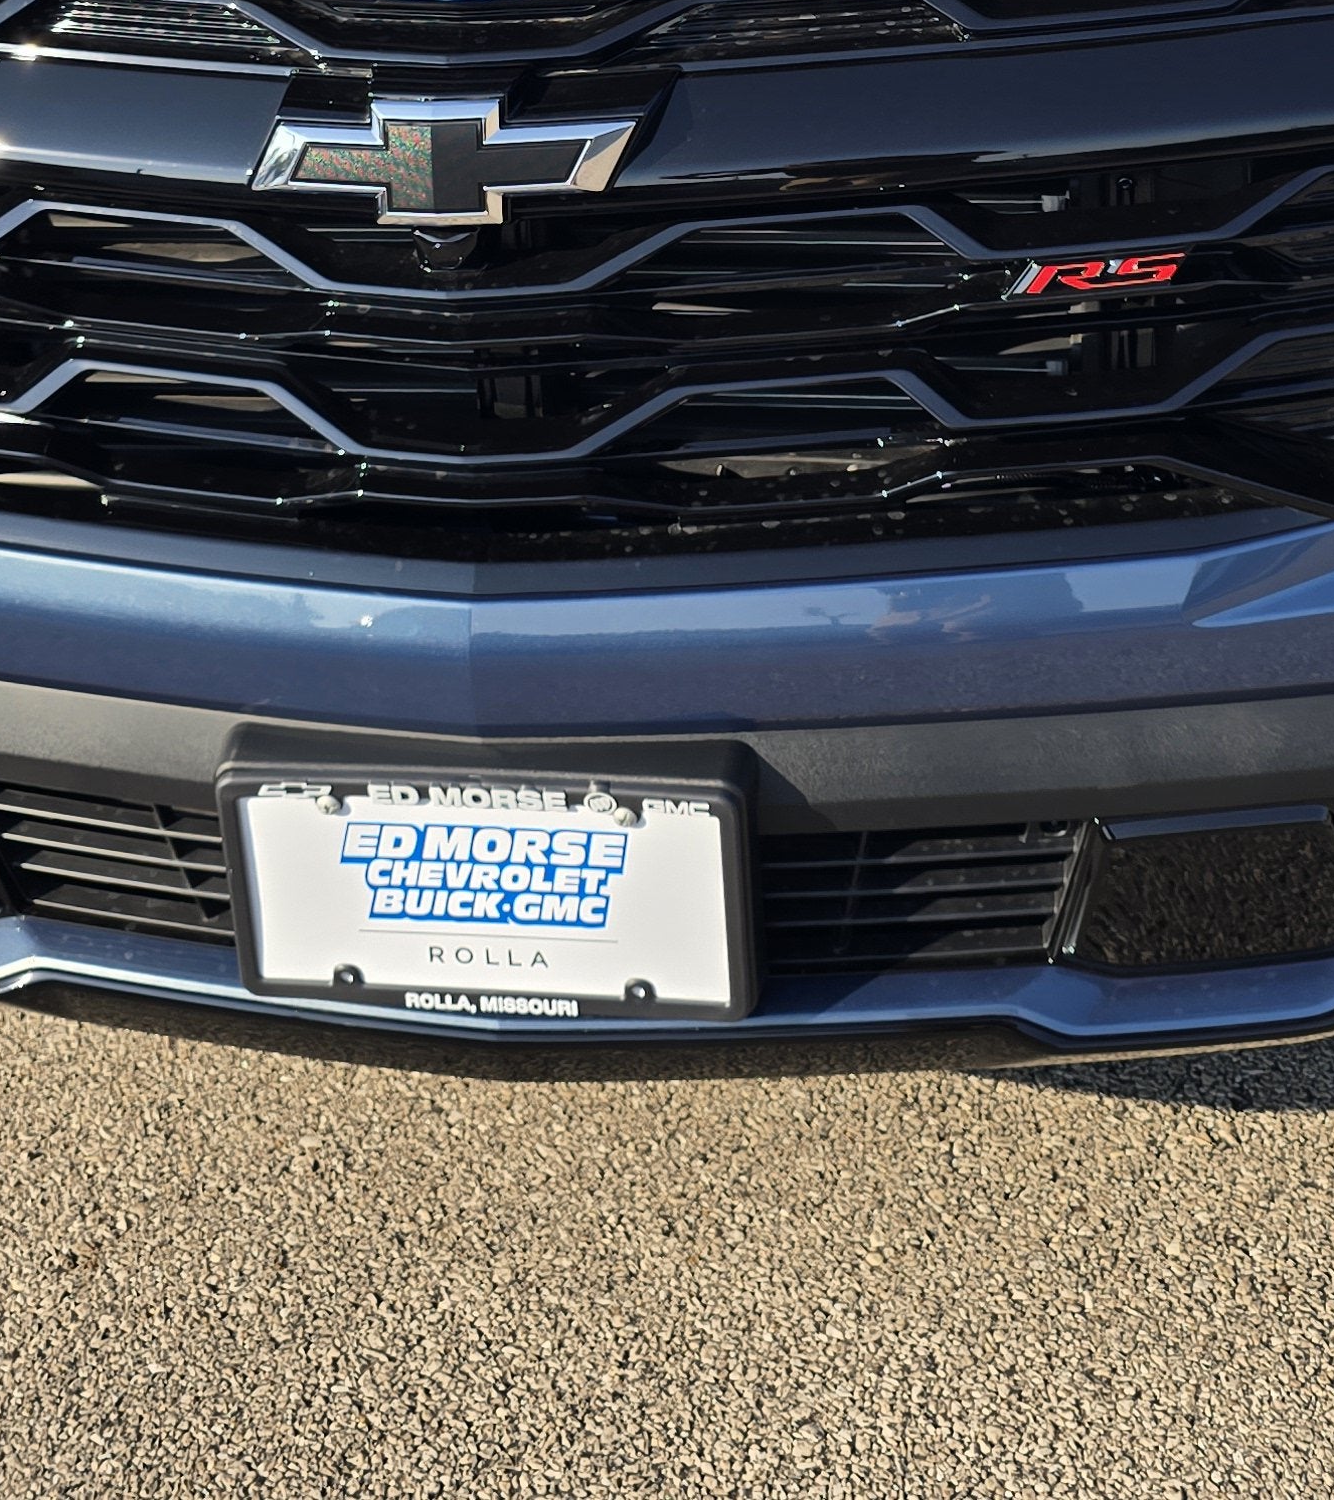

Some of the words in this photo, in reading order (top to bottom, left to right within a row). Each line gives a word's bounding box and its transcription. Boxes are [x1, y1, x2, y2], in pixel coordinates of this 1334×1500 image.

[1013, 252, 1186, 295] RS
[367, 783, 420, 806] ED
[428, 786, 567, 812] MORSE
[642, 798, 710, 817] GMC
[342, 823, 418, 860] ED
[421, 825, 627, 869] MORSE
[366, 858, 607, 895] CHEVROLET
[428, 945, 549, 968] ROLLA
[404, 991, 477, 1015] ROLLA,
[479, 995, 579, 1018] MISSOURI
